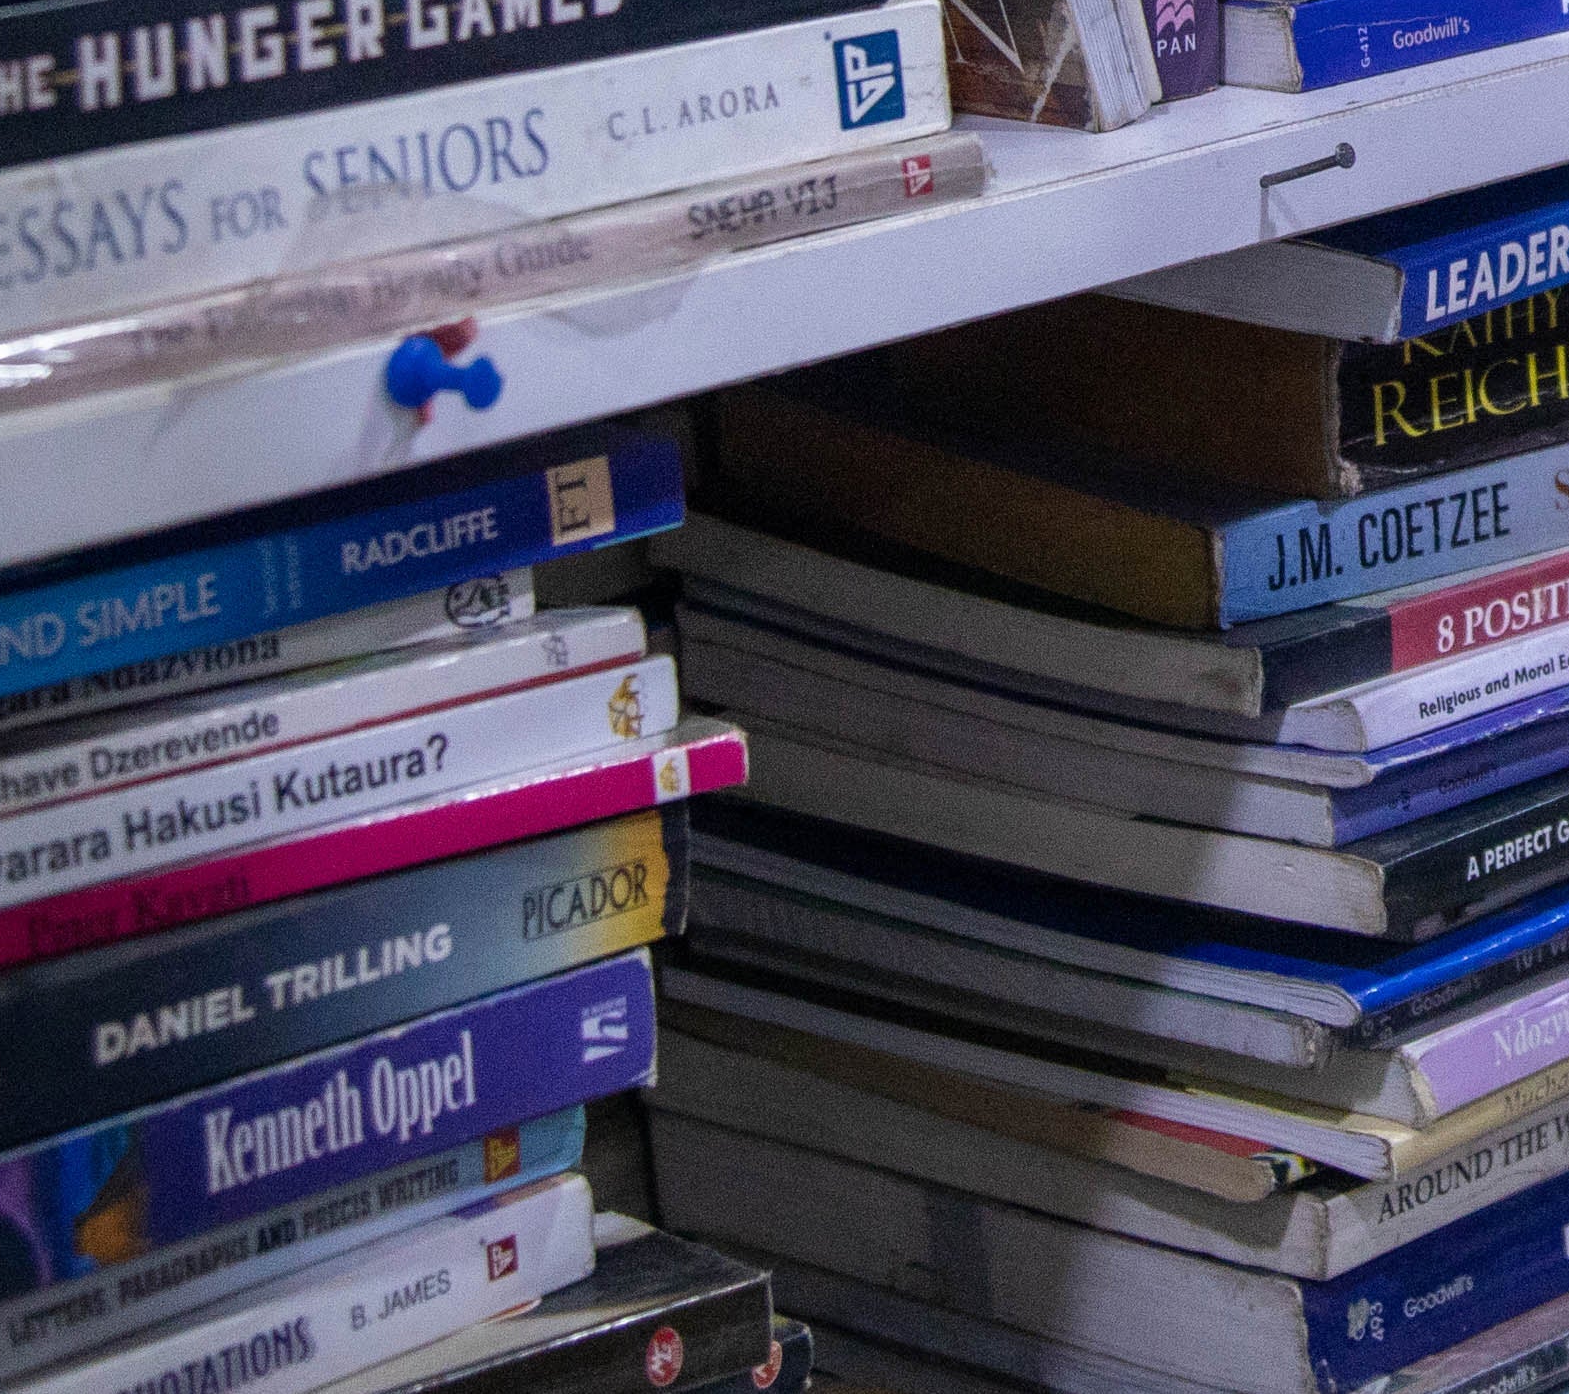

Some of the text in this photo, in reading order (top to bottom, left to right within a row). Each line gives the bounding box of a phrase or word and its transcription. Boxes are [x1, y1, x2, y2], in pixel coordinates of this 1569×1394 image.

[1157, 32, 1197, 59] PAN
[1393, 18, 1470, 49] Goodwill's
[303, 108, 550, 214] SENIORS
[678, 84, 780, 128] ARORA
[1268, 535, 1344, 591] J.M.
[1359, 482, 1511, 567] COETZEE
[79, 570, 220, 646] SIMPLE
[341, 507, 498, 575] RADCLIFFE
[1418, 686, 1482, 720] Religious
[1485, 674, 1511, 696] and
[1514, 657, 1556, 687] Moral
[90, 712, 280, 784] Dzerevende
[123, 790, 263, 852] Hakusi
[274, 734, 449, 814] Kutaura?
[1466, 856, 1481, 883] A
[1484, 826, 1553, 881] PERFECT
[520, 861, 648, 939] PICADOR
[93, 922, 454, 1066] DANIEL TRILLING
[204, 1028, 477, 1197] Kenneth Oppel
[378, 1269, 452, 1324] JAMES
